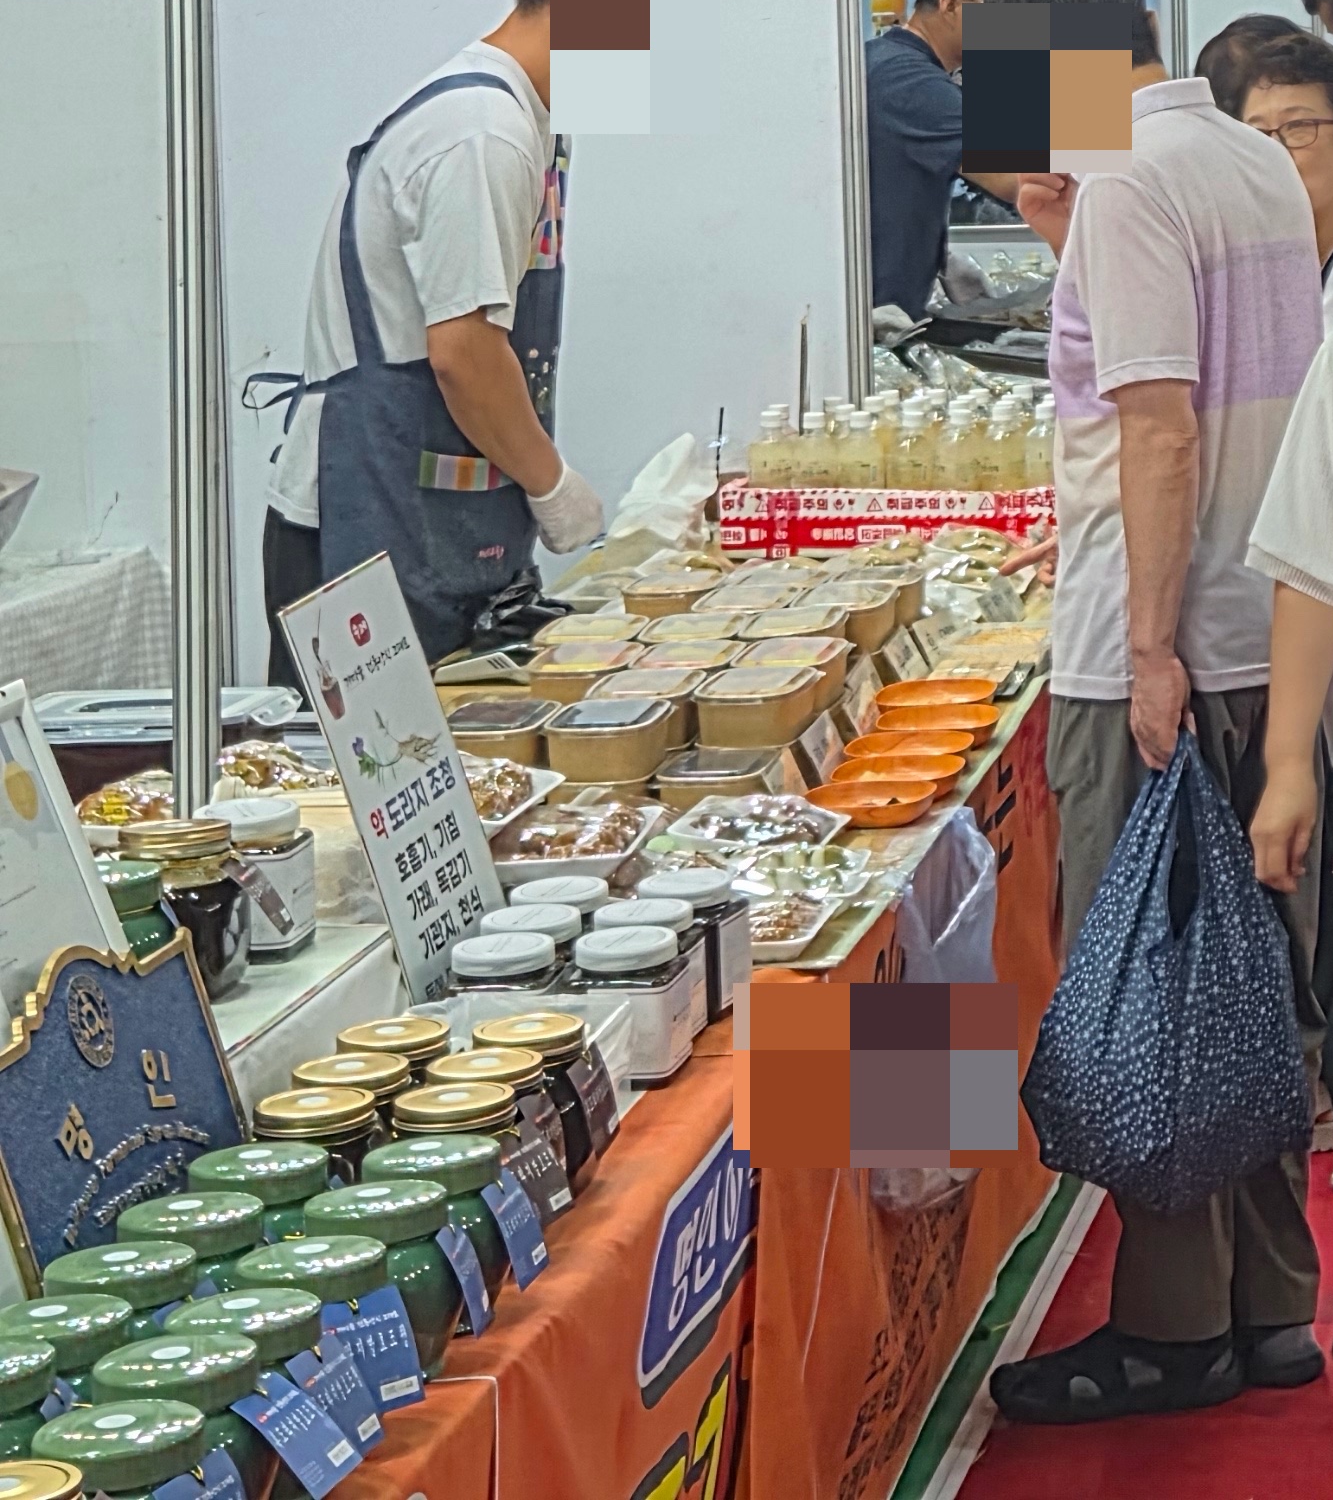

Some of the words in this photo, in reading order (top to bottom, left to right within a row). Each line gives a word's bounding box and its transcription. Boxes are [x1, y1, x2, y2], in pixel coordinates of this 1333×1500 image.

[385, 777, 430, 832] 도라지
[426, 757, 456, 801] 조청
[395, 832, 437, 883] 호흡기,
[434, 810, 461, 849] 기침
[435, 849, 473, 895] 목감기
